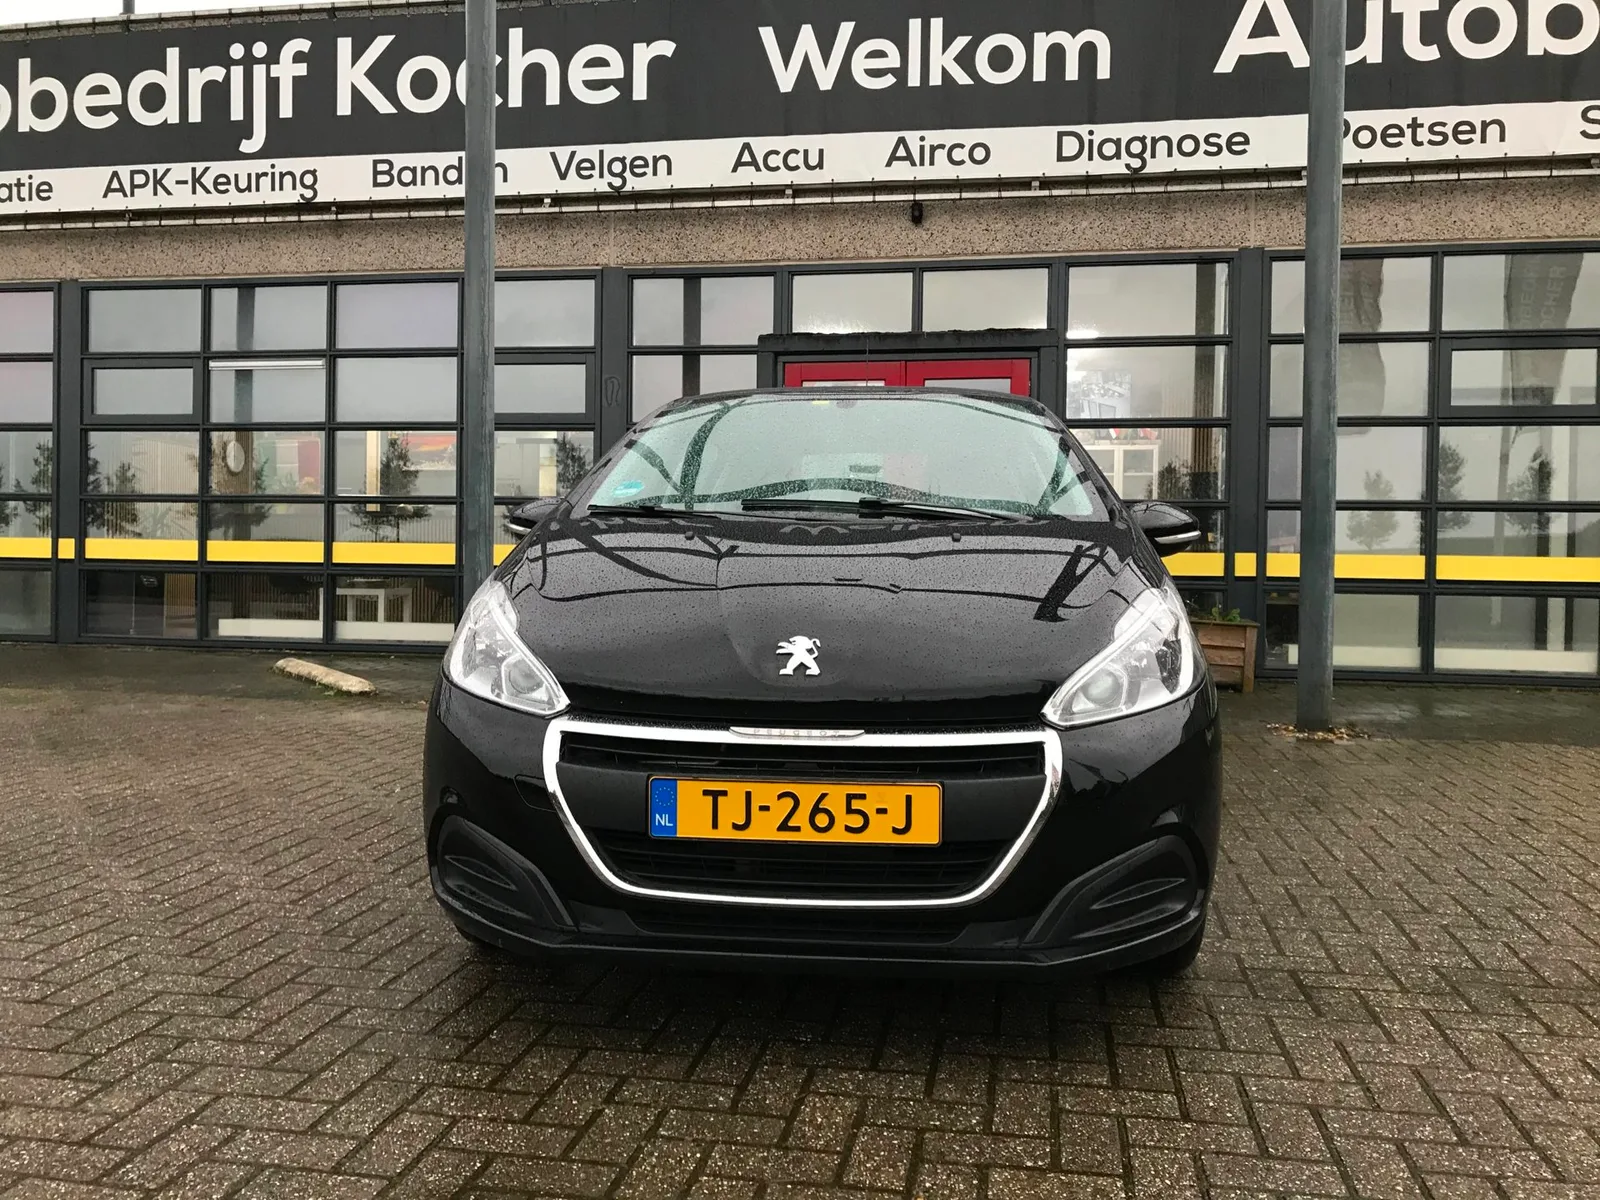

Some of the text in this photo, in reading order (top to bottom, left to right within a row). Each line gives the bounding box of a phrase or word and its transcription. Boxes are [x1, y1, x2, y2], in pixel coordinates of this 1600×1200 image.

[0, 41, 312, 154] bedrijf
[757, 16, 1111, 94] Welkom
[0, 174, 53, 203] atie
[102, 163, 318, 202] APK-Keuring
[372, 156, 508, 188] Bandn
[549, 149, 673, 191] Velgen
[731, 141, 825, 173] Accu
[885, 135, 991, 168] Airco
[1056, 129, 1251, 173] Diagnose
[655, 814, 673, 827] NL
[702, 789, 913, 835] TJ-265-J
